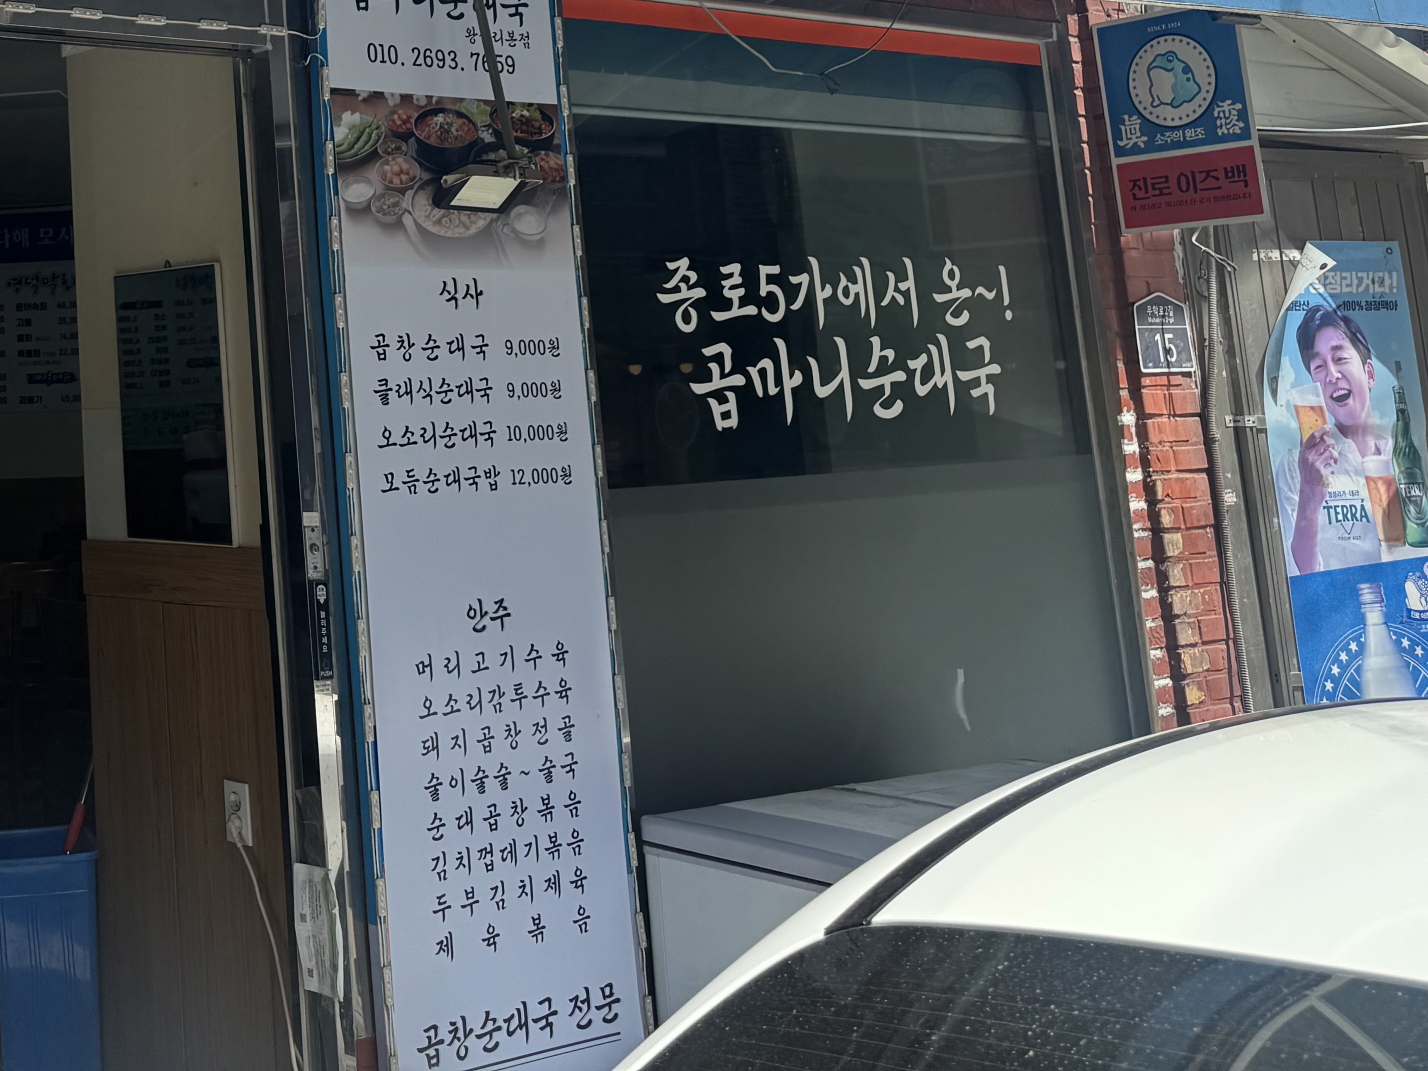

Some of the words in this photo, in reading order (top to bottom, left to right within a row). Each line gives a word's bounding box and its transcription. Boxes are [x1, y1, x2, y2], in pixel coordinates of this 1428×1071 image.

[464, 26, 531, 50] 왕리본점
[1155, 130, 1184, 146] 소주의
[1185, 127, 1206, 141] 원조
[1128, 174, 1174, 202] 진로
[1176, 168, 1222, 194] 이즈
[1224, 163, 1249, 189] 백
[438, 277, 484, 310] 식사
[656, 256, 919, 333] 종로5가에서
[932, 256, 1013, 327] 온~!
[369, 332, 490, 362] 곱창순대국
[504, 337, 561, 359] 9,000원
[1154, 332, 1178, 363] 15
[373, 376, 494, 406] 클래식순대국
[506, 379, 562, 401] 9,000원
[689, 333, 1002, 432] 곱마니순대국
[377, 420, 498, 450] 오소리순대국
[506, 422, 568, 444] 10,000원
[380, 464, 501, 495] 모듬순대국밥
[510, 464, 573, 488] 12,000원
[1322, 504, 1371, 526] TERRA
[466, 597, 513, 633] 안주
[418, 676, 573, 721] 오소리감투수육
[430, 827, 585, 883] 김치껍데기볶음
[416, 996, 559, 1068] 곱창순대국
[567, 981, 622, 1032] 전문
